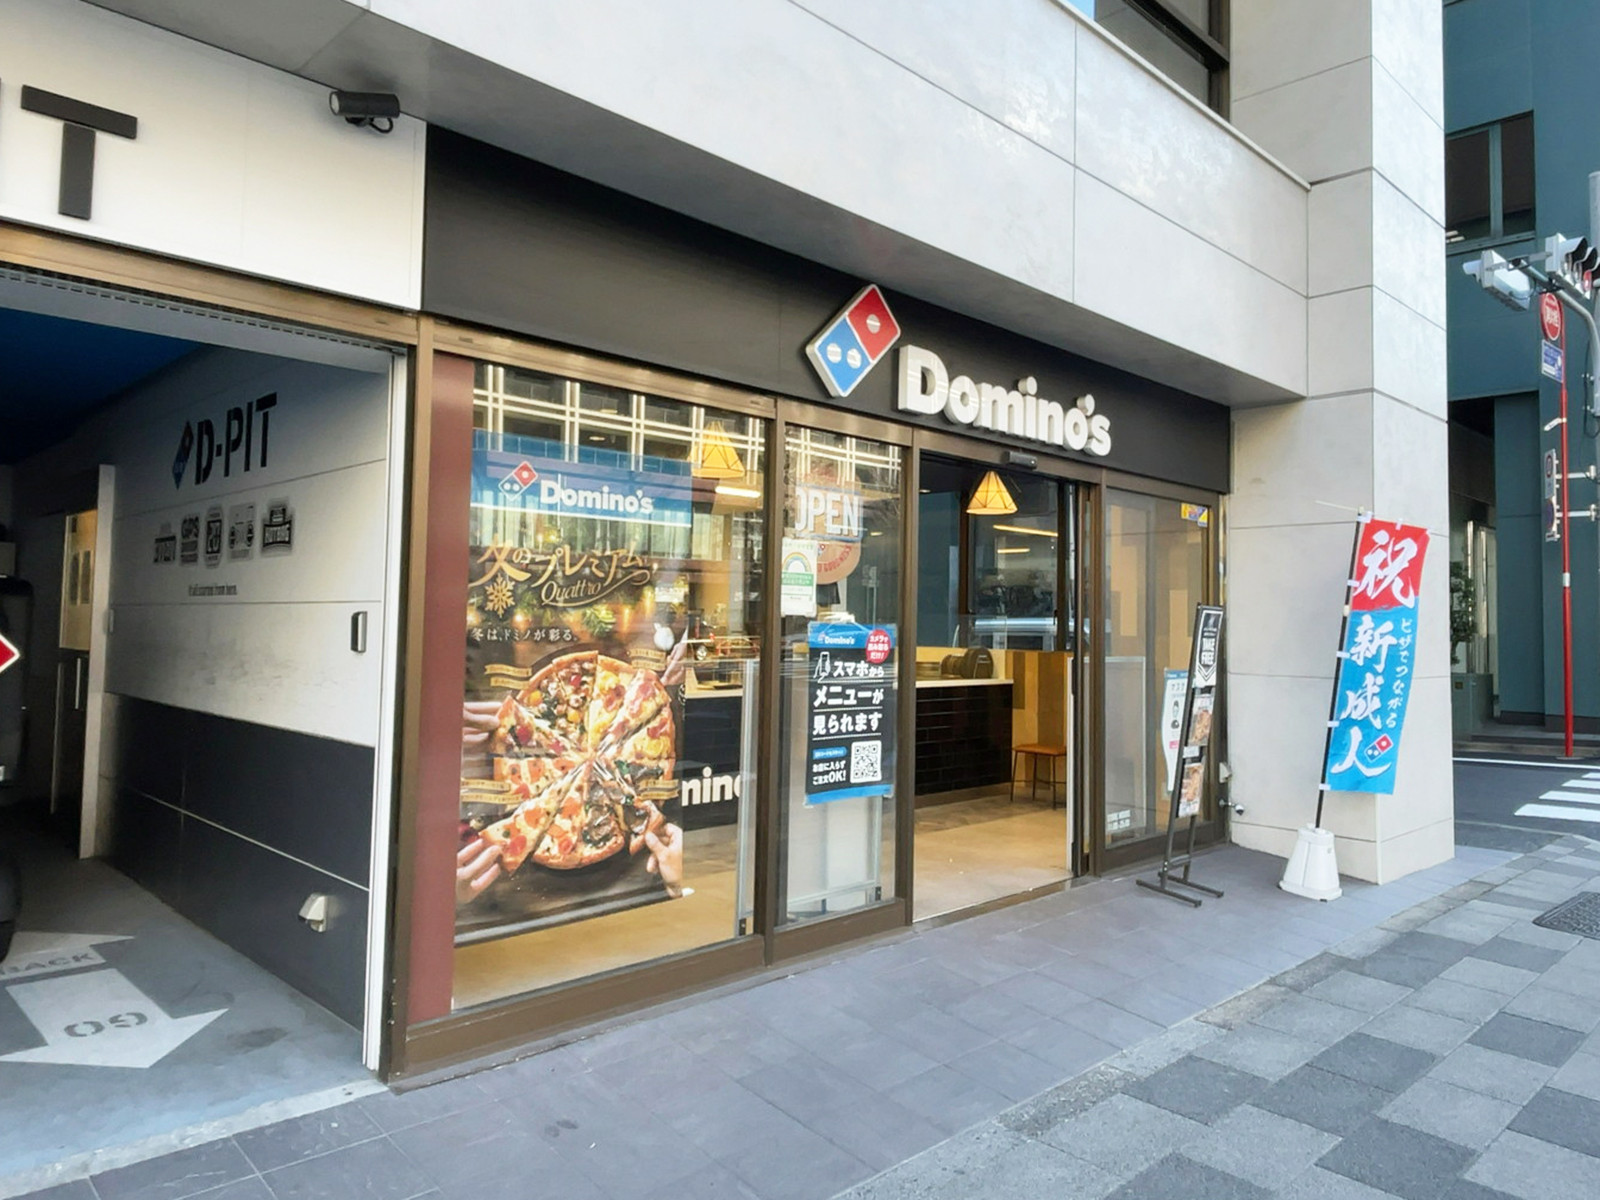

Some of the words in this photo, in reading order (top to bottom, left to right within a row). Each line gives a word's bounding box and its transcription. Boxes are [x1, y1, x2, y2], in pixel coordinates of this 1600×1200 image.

[897, 344, 1112, 457] Domino's
[195, 392, 277, 486] D-PIT
[540, 479, 654, 514] Domino's
[1353, 529, 1418, 609] 祝
[541, 578, 603, 606] Quattro
[824, 636, 855, 645] Domino's
[832, 660, 885, 678] スマホから
[813, 685, 884, 708] メニューが
[1331, 614, 1398, 777] 新成人
[812, 711, 882, 736] 見られます
